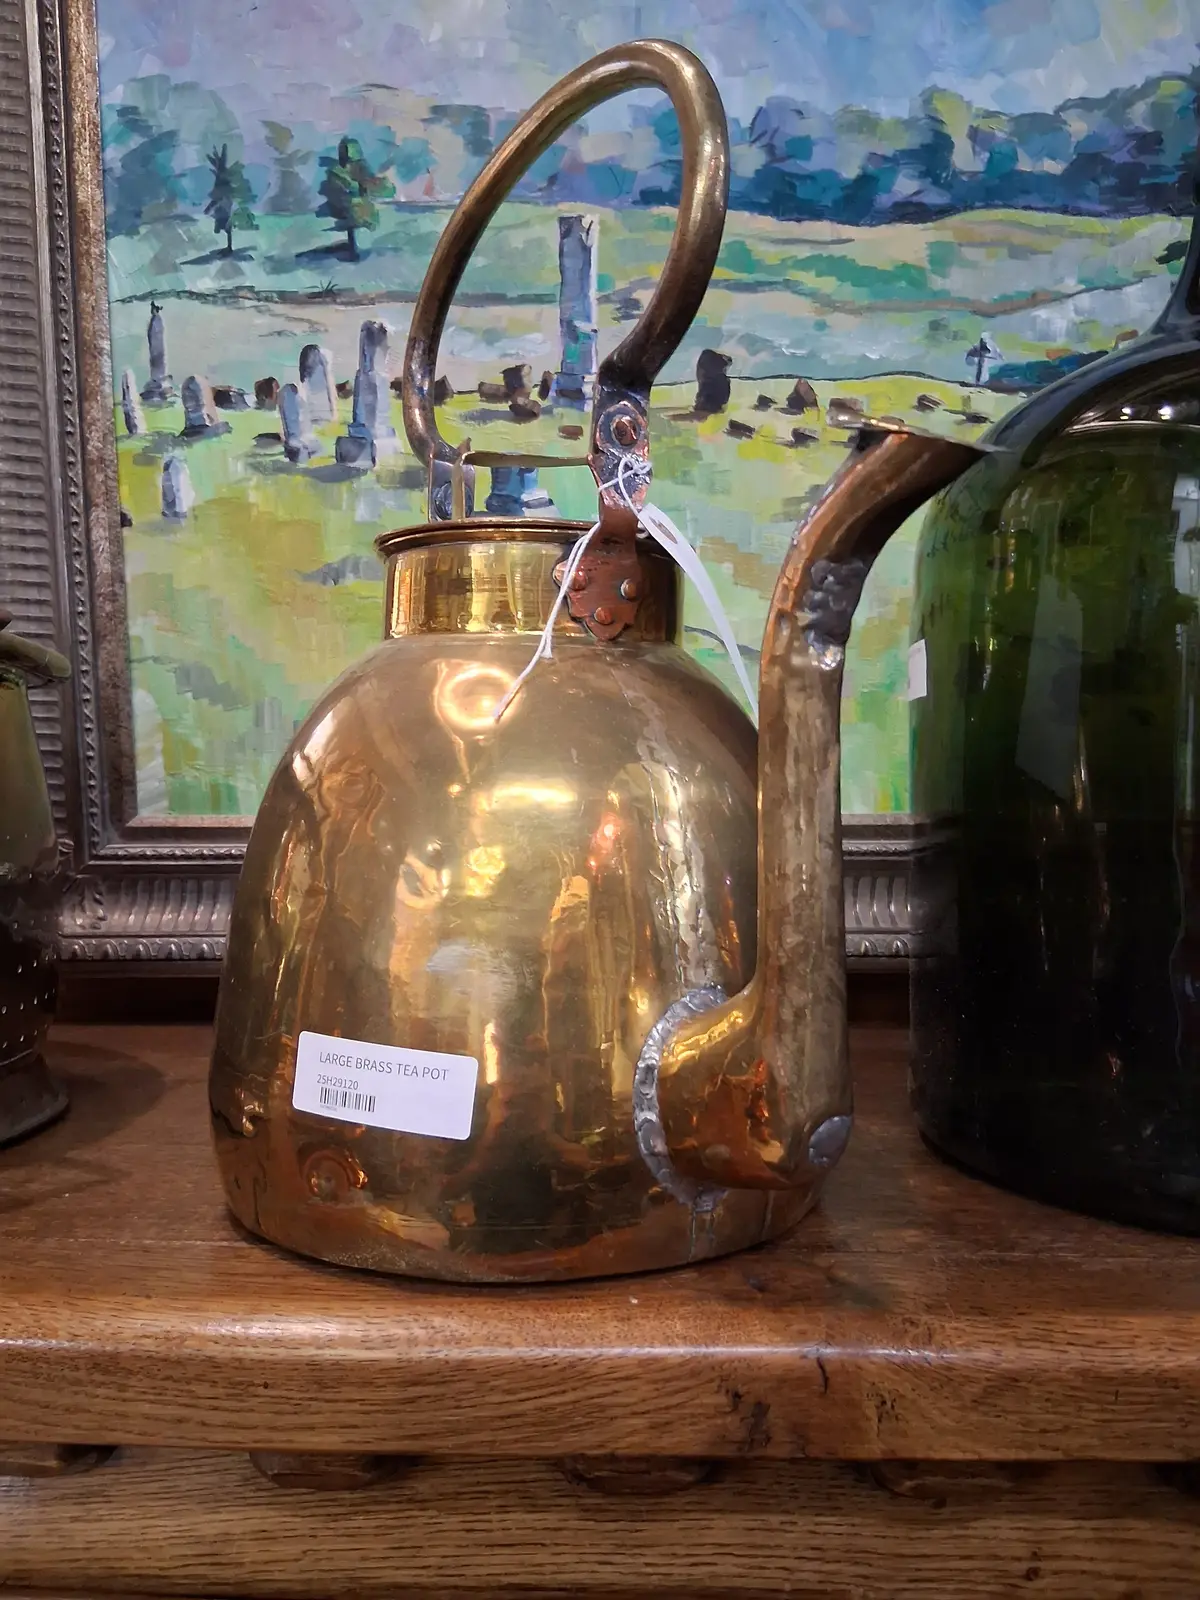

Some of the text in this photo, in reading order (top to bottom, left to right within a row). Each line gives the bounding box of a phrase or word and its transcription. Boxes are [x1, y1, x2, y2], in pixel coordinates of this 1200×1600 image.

[319, 1051, 449, 1081] LARGE BRASS TEA POT
[316, 1073, 359, 1091] 25H29120
